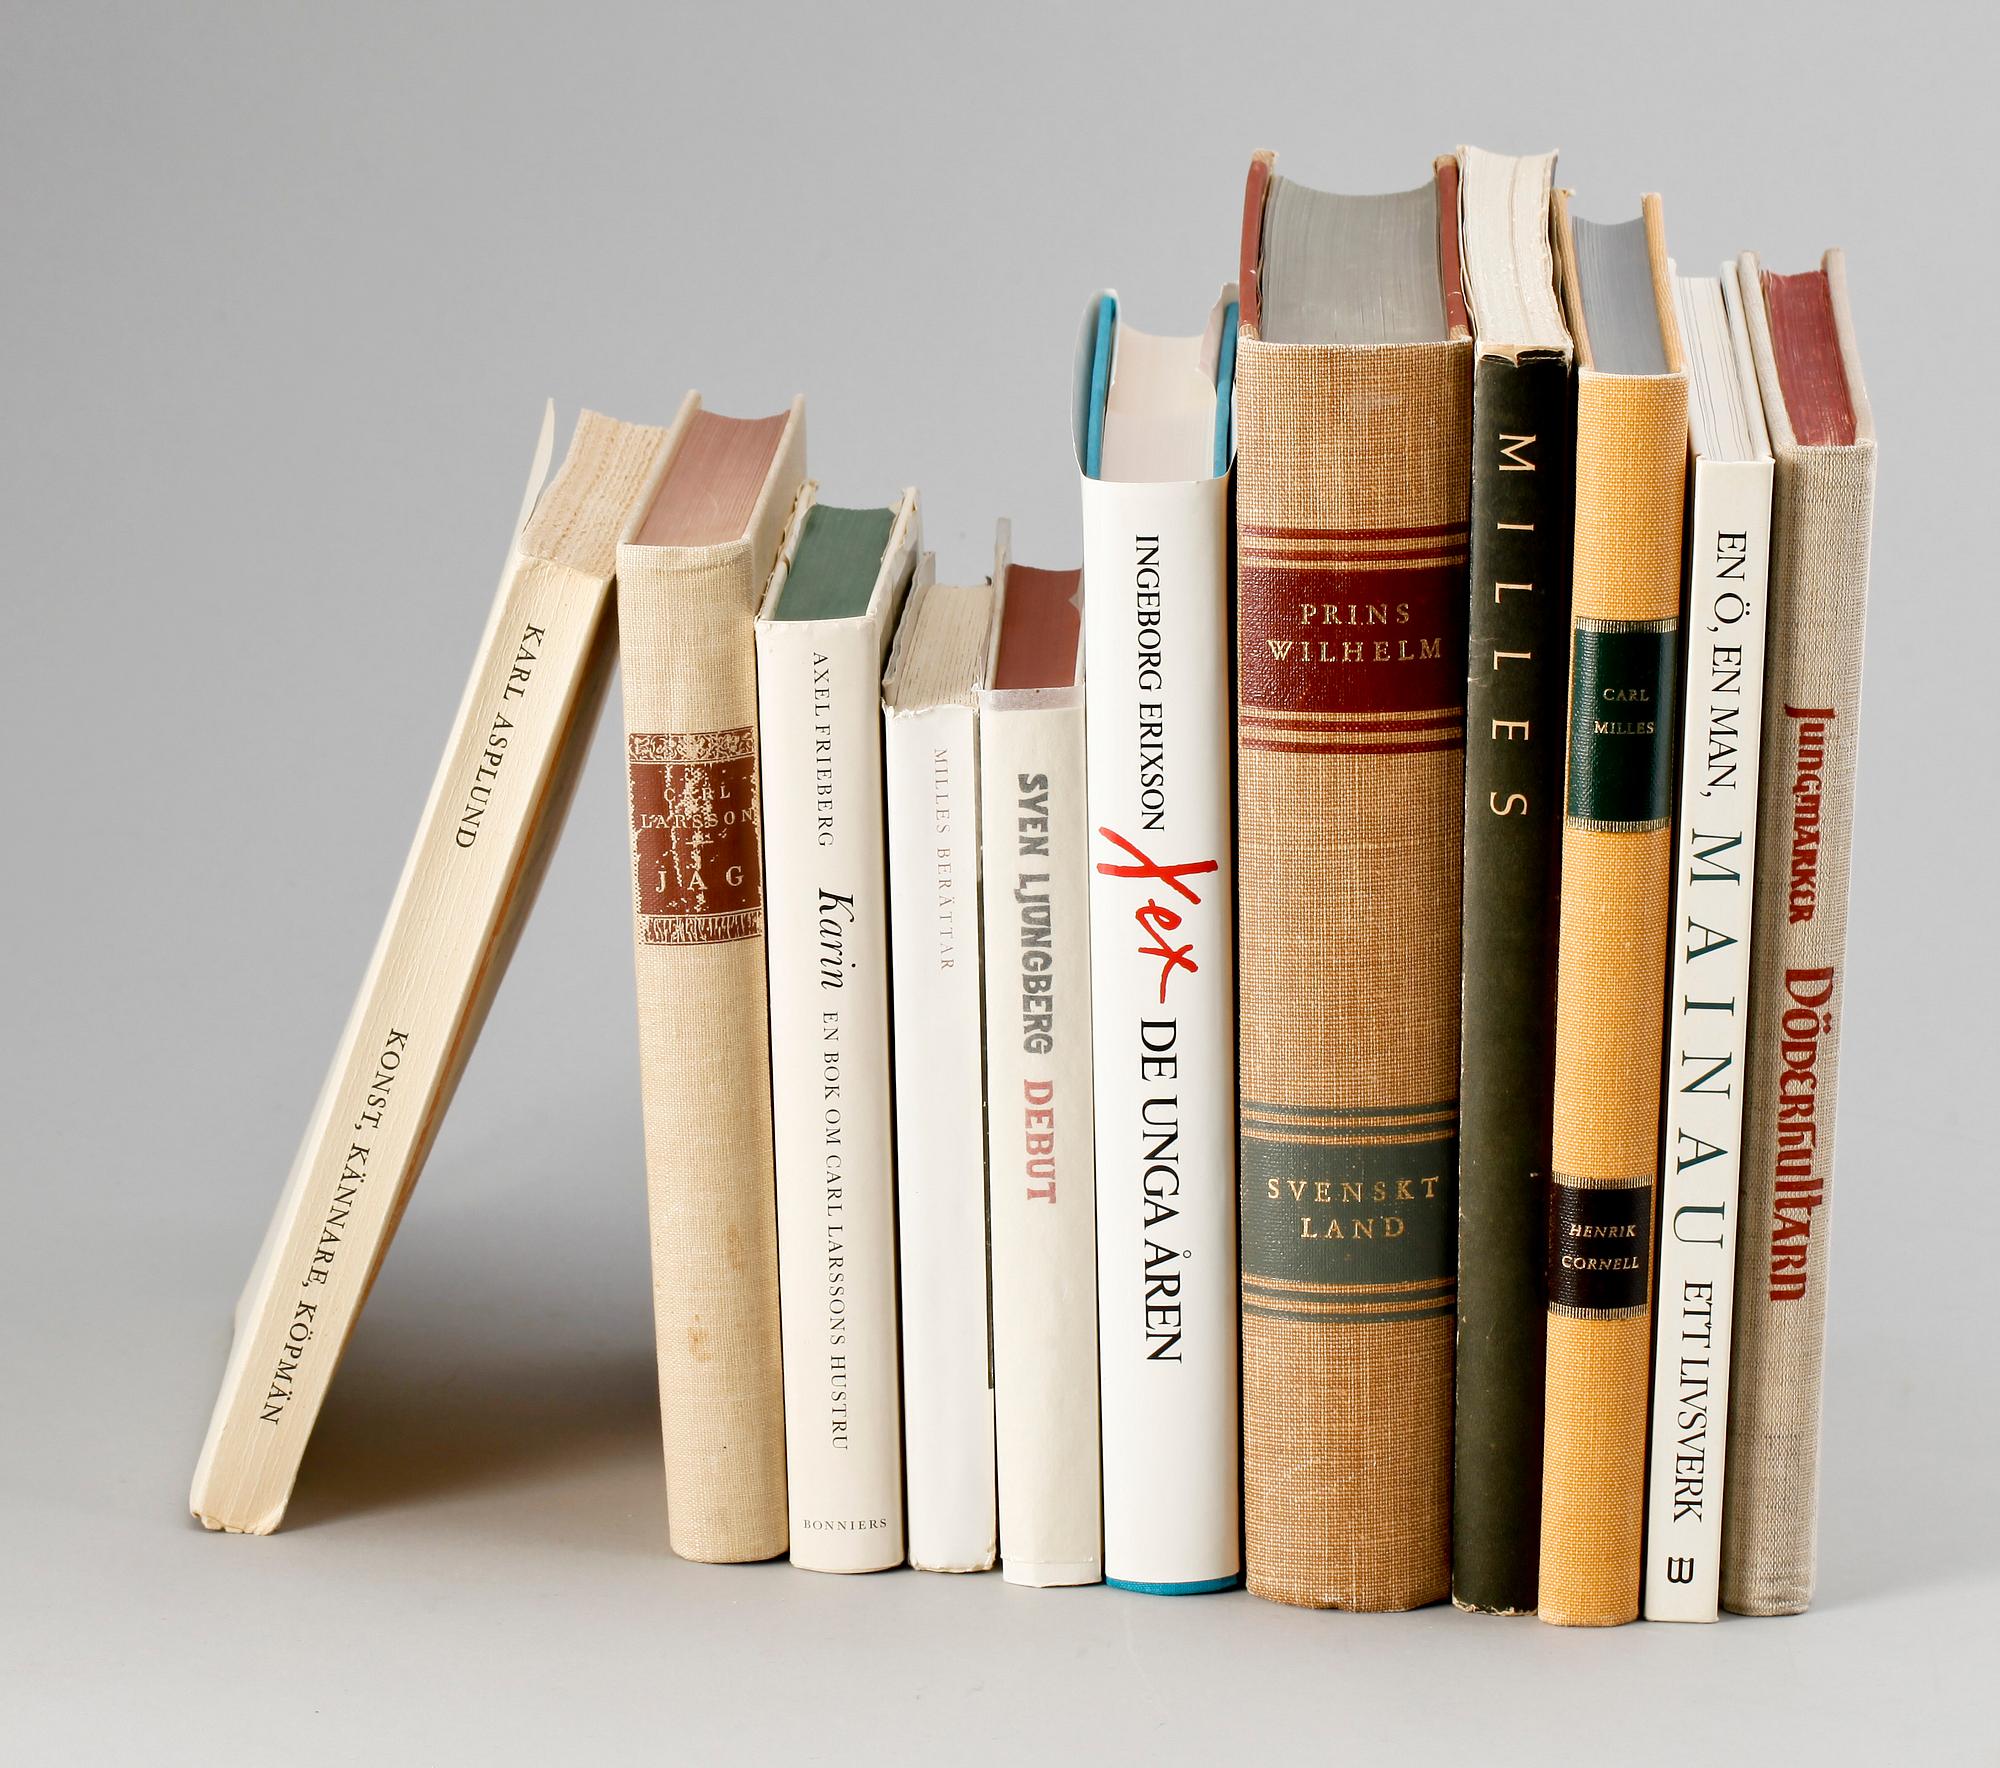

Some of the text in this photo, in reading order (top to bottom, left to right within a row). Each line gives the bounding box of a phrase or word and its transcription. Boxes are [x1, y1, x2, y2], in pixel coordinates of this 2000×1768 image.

[1135, 534, 1163, 692] INGEBORG
[1299, 603, 1411, 626] PRINS
[1489, 433, 1537, 817] MILLES
[1266, 638, 1442, 663] WILHELM
[1602, 687, 1650, 703] CARL
[455, 623, 545, 848] KARL ASPLUND
[1593, 721, 1655, 736] MILLES
[663, 785, 731, 803] CARL
[1138, 702, 1165, 831] ERIXSON
[641, 808, 753, 829] LARSSON
[933, 749, 955, 971] MILLES BERÄTTAR
[1014, 773, 1057, 1204] SVEN LJUNGBERG DEBUT
[812, 652, 856, 1451] AXEL FRIEBERG Karin EN BOK OM CARL LARSSONS HUSTRU
[1140, 1017, 1178, 1082] DE
[1673, 530, 1752, 1523] EN Ö, EN MAN, MAINAU ETT LIVSVERK
[1141, 1094, 1181, 1230] UNGA
[1267, 1176, 1440, 1204] SVENSKT
[259, 1028, 409, 1425] KONST, KÄNNARE, KÖPMÄN
[1300, 1216, 1406, 1240] LAND
[1570, 1223, 1637, 1239] HENRIK
[1561, 1255, 1640, 1272] CORNELL
[1143, 1238, 1192, 1364] ÅREN
[803, 1518, 887, 1531] BONNIERS
